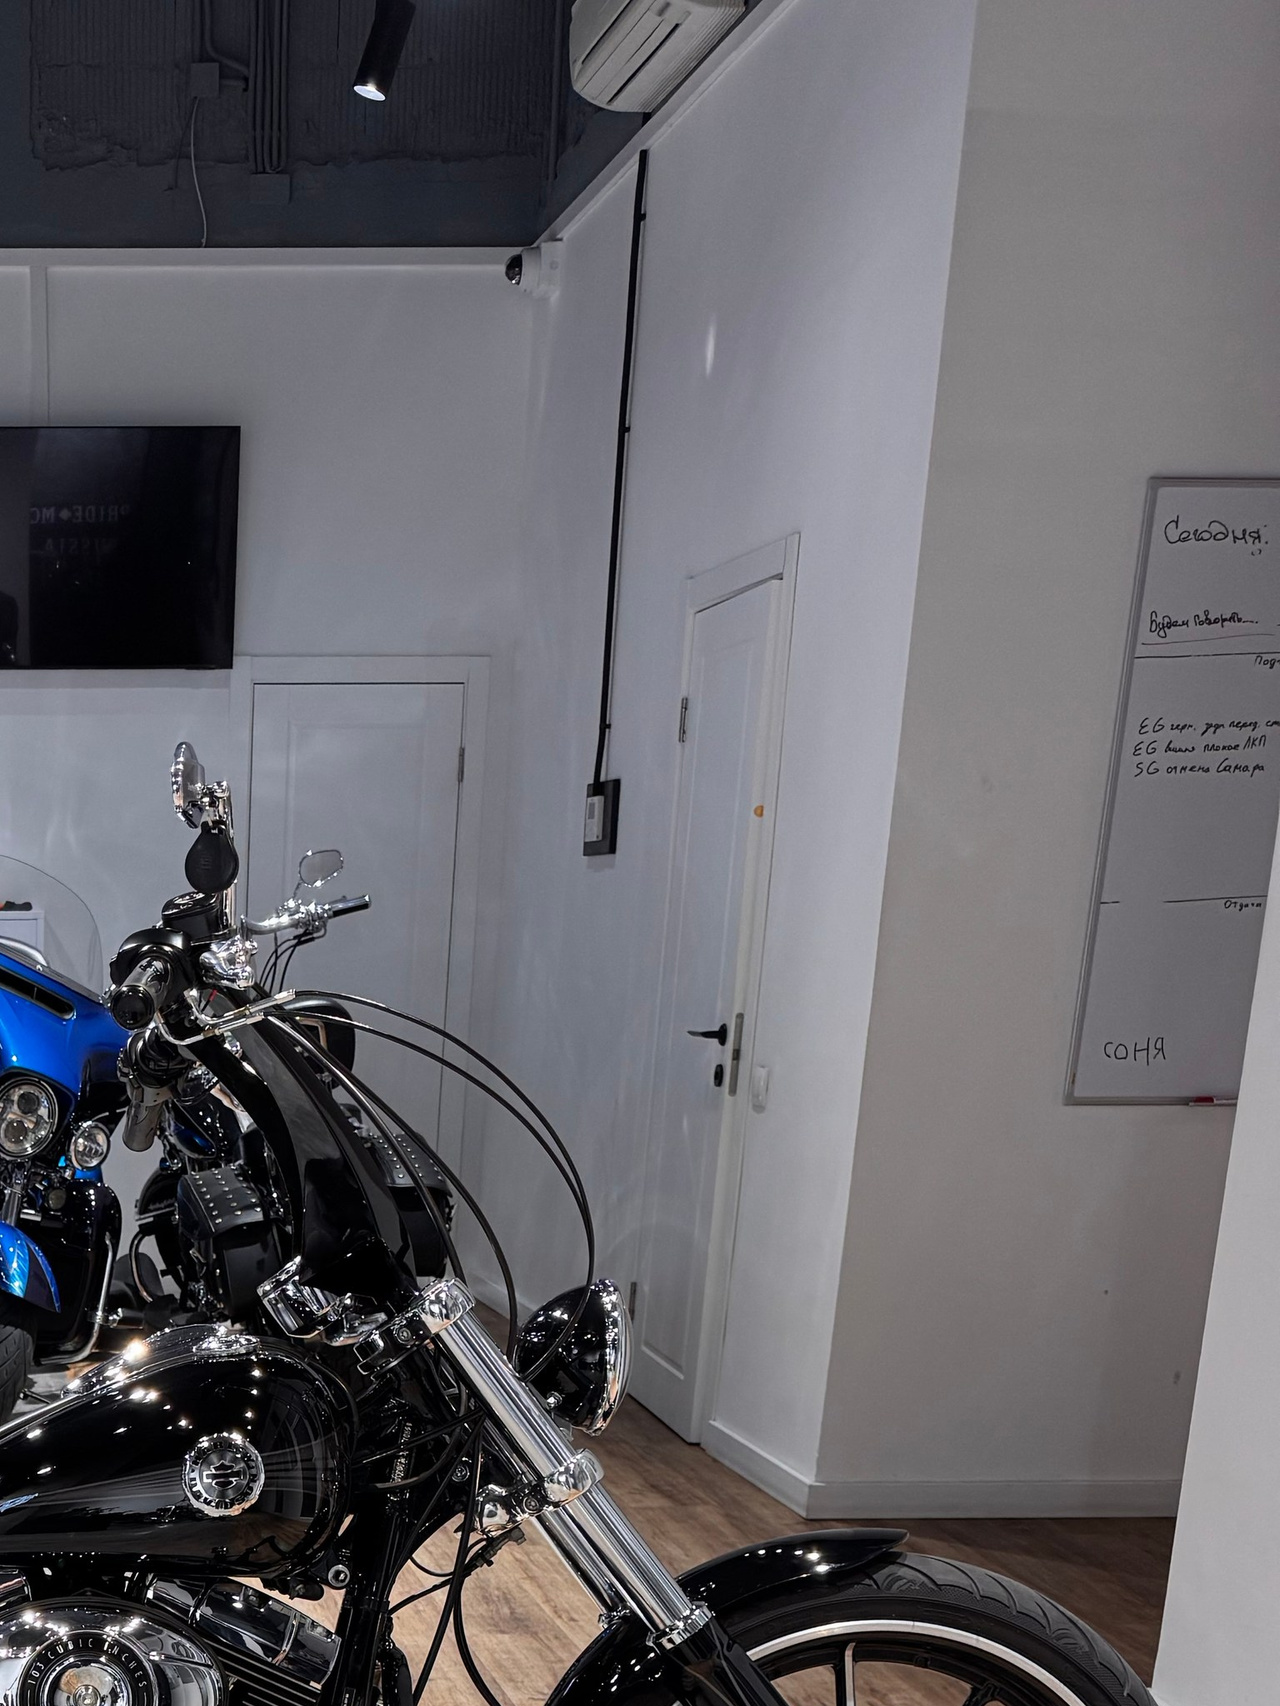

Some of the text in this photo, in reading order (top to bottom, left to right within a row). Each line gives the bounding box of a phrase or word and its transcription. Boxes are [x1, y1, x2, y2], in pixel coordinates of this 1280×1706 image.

[1254, 655, 1280, 669] Под
[28, 1637, 148, 1688] 103 CUBIC INCHES
